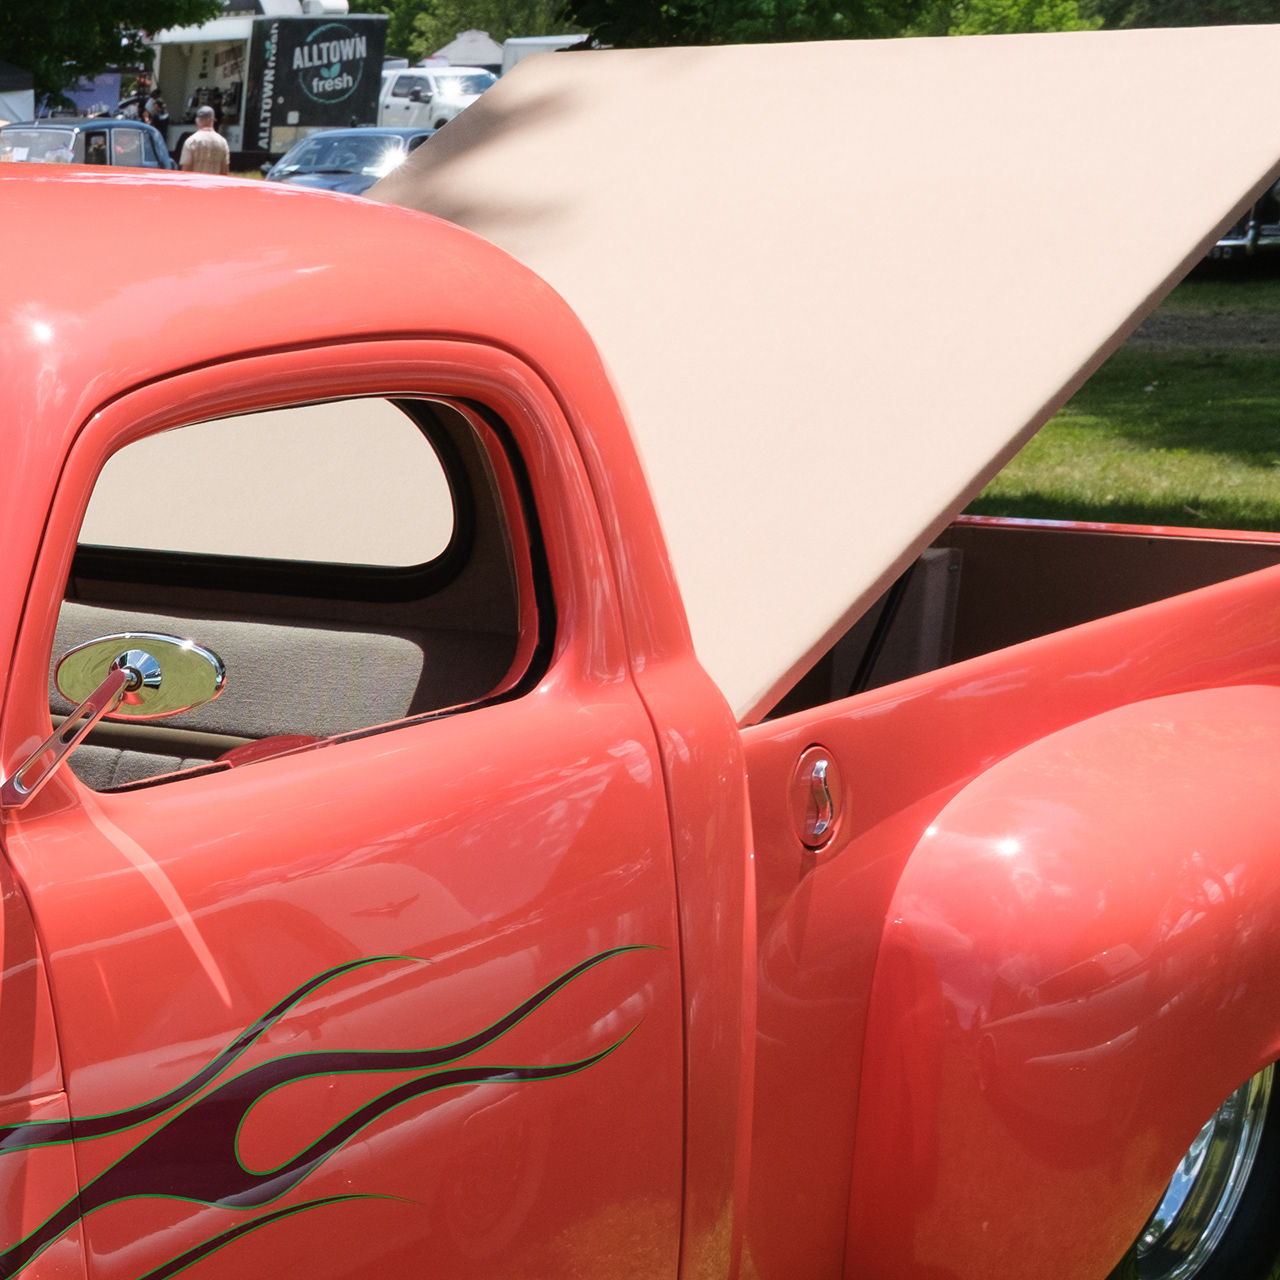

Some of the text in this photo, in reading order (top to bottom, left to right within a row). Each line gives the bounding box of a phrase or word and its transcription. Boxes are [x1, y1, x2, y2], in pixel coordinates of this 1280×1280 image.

[292, 35, 368, 70] ALLTOWN
[258, 22, 279, 149] ALLTOWN fresh
[312, 72, 354, 94] fresh
